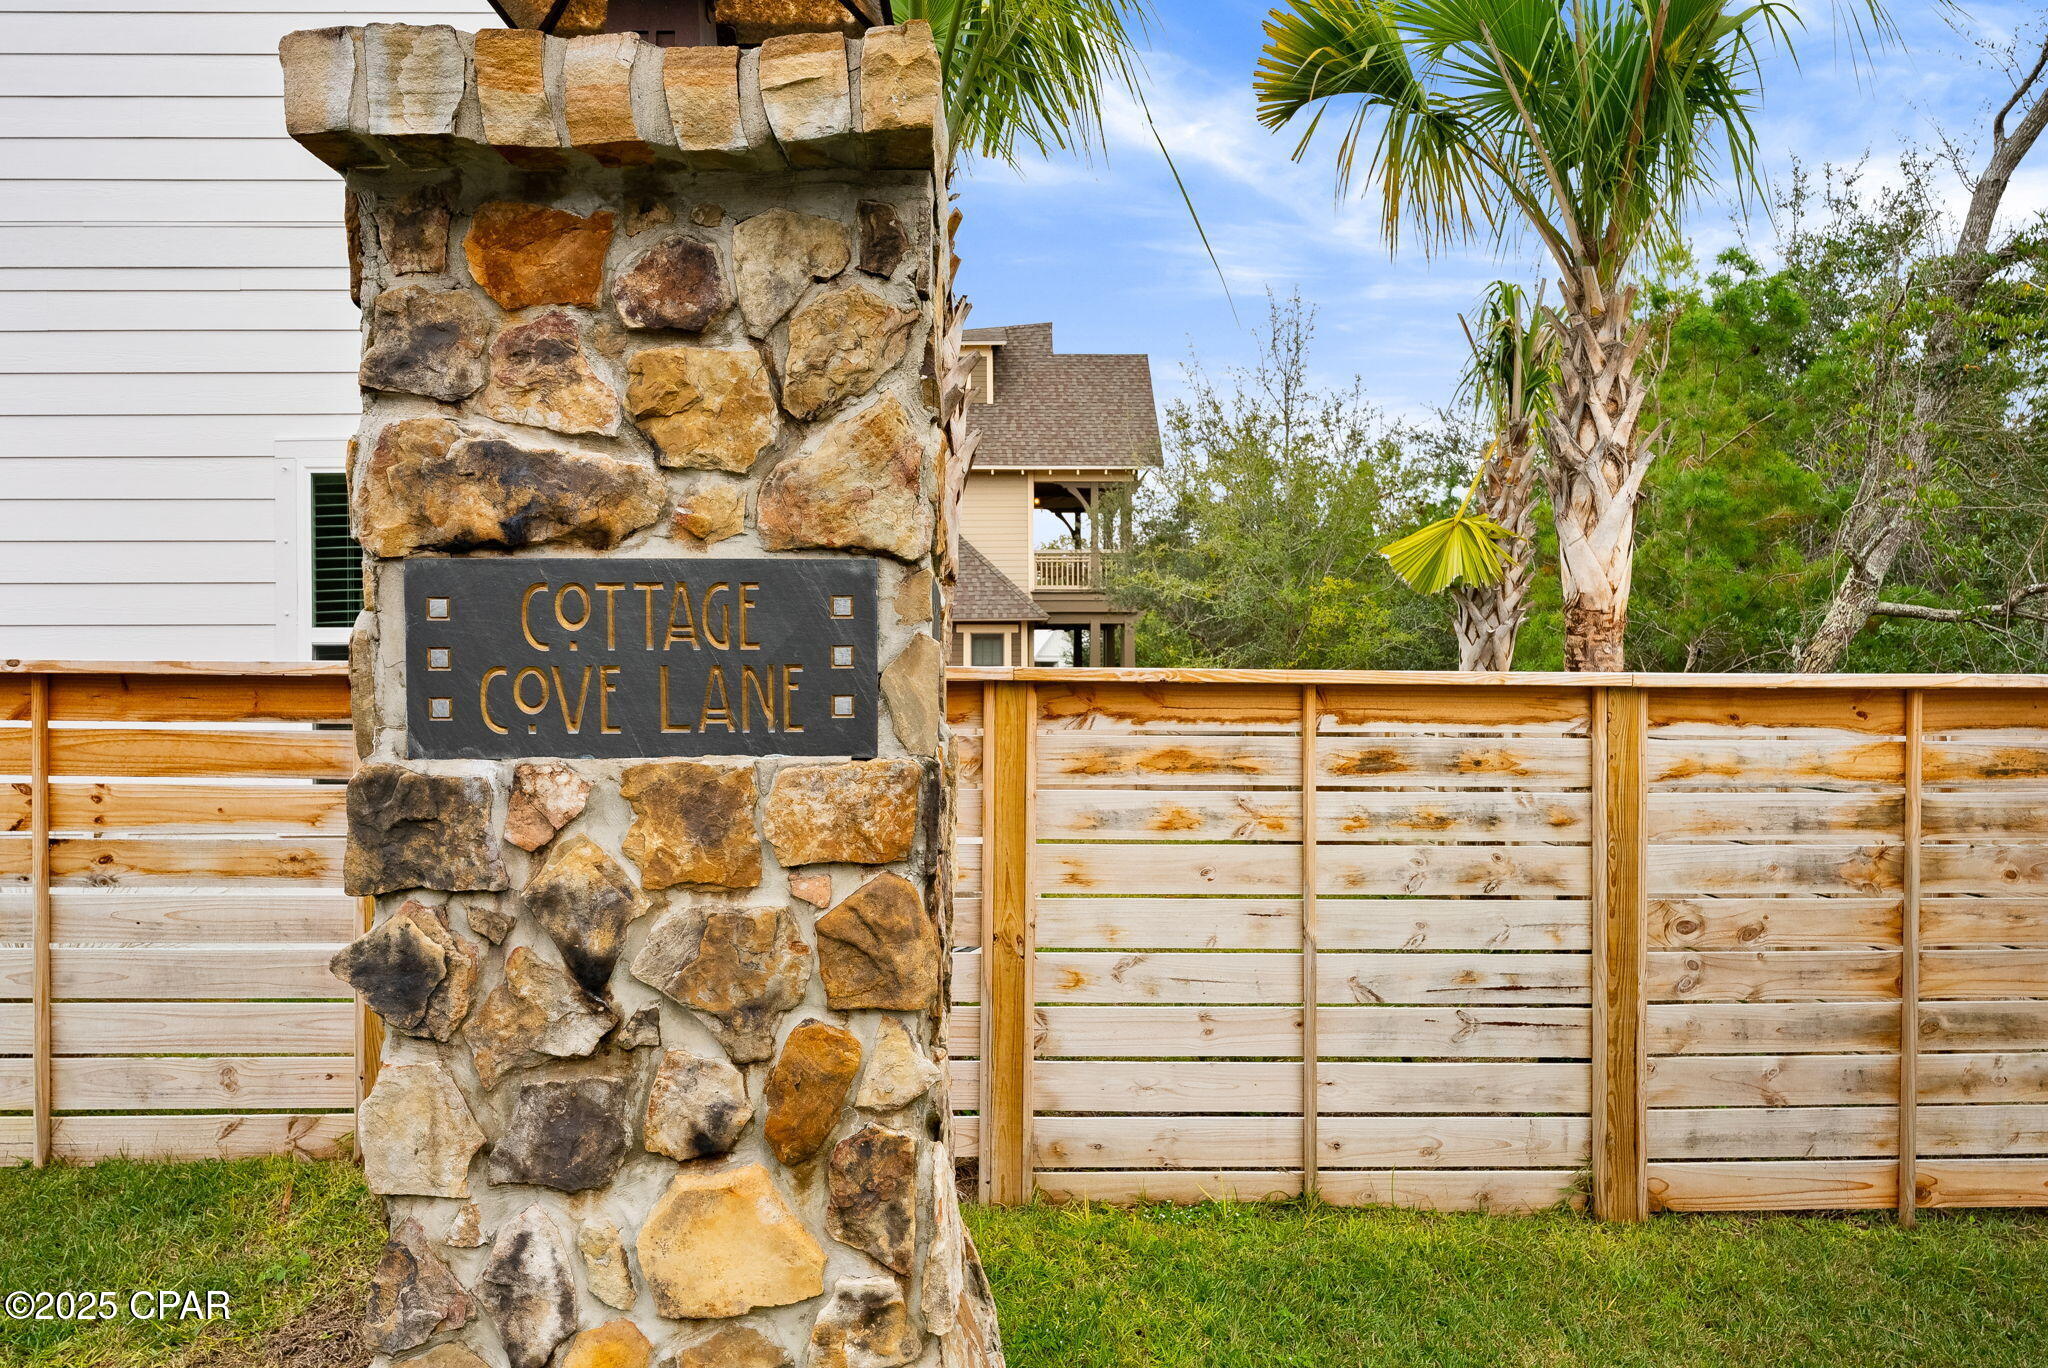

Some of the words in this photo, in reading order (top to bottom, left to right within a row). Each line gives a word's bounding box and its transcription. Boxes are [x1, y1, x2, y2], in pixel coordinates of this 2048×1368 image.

[521, 582, 761, 651] COTTAGE
[480, 665, 622, 734] COVE
[660, 664, 805, 733] LANE
